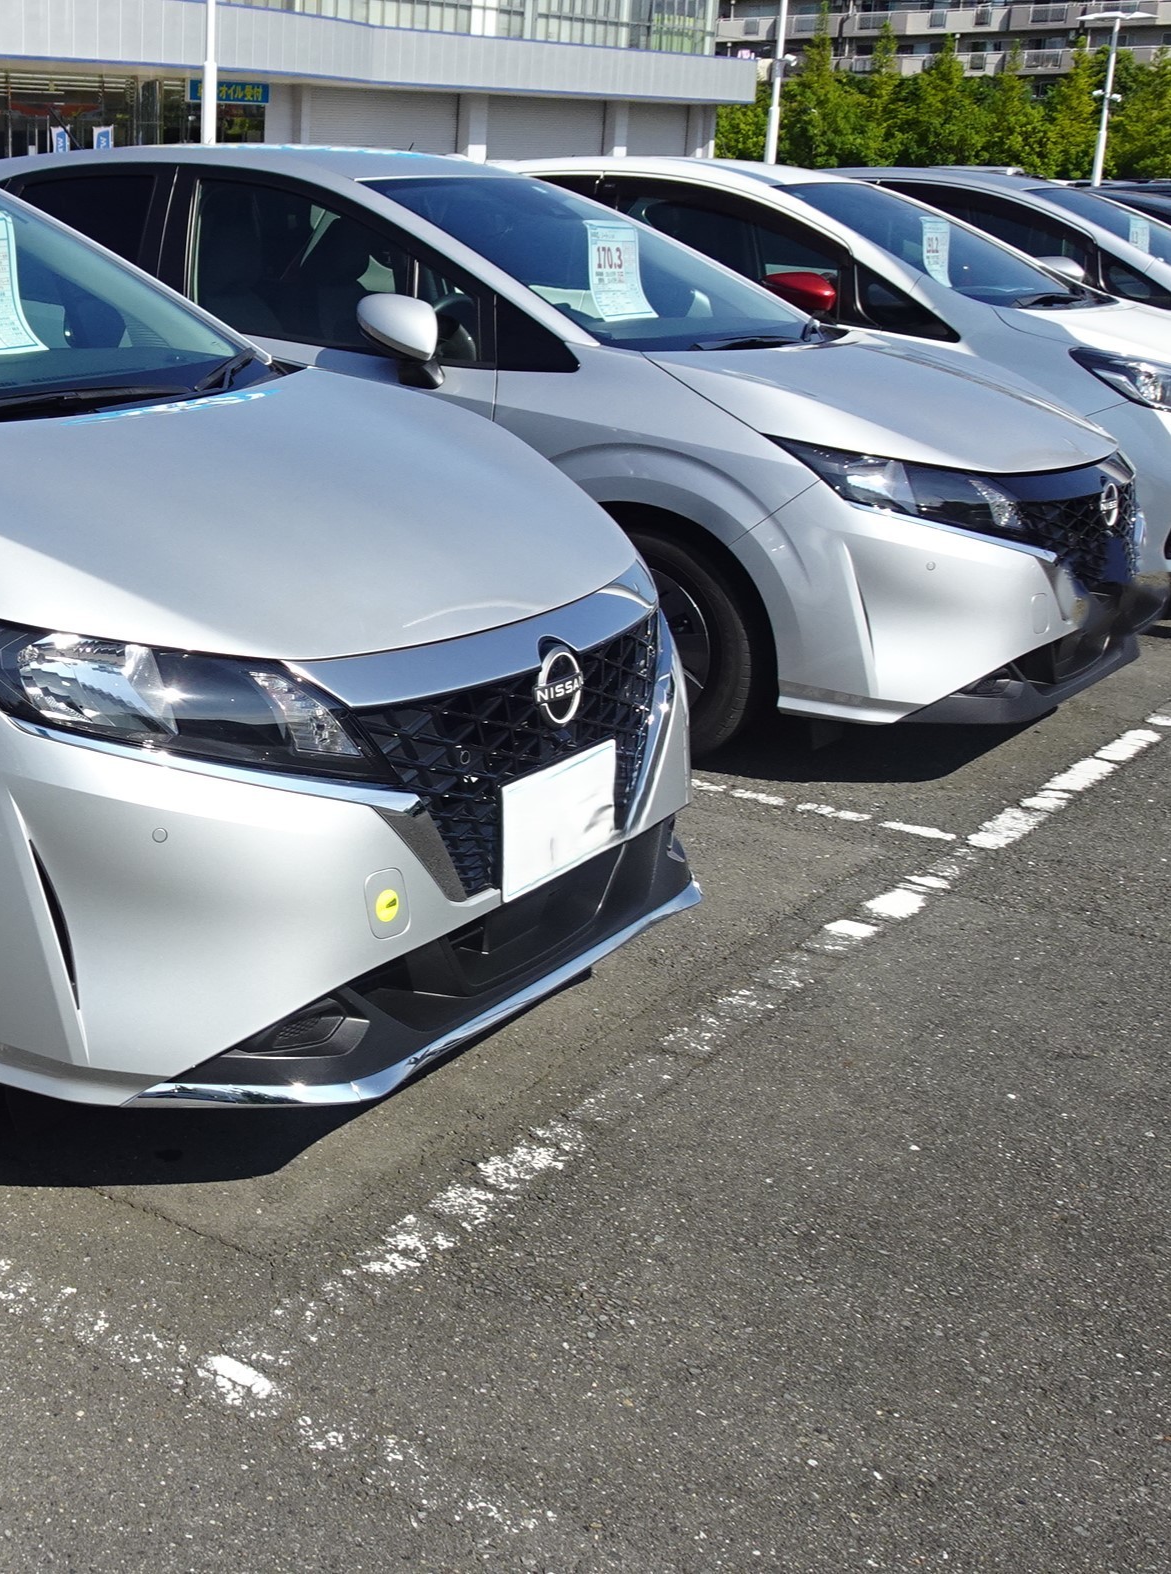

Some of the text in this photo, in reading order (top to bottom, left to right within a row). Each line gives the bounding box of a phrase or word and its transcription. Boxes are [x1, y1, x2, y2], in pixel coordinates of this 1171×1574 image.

[198, 83, 262, 101] オイル受付
[597, 246, 623, 269] 170.3
[536, 675, 584, 702] NISSAN
